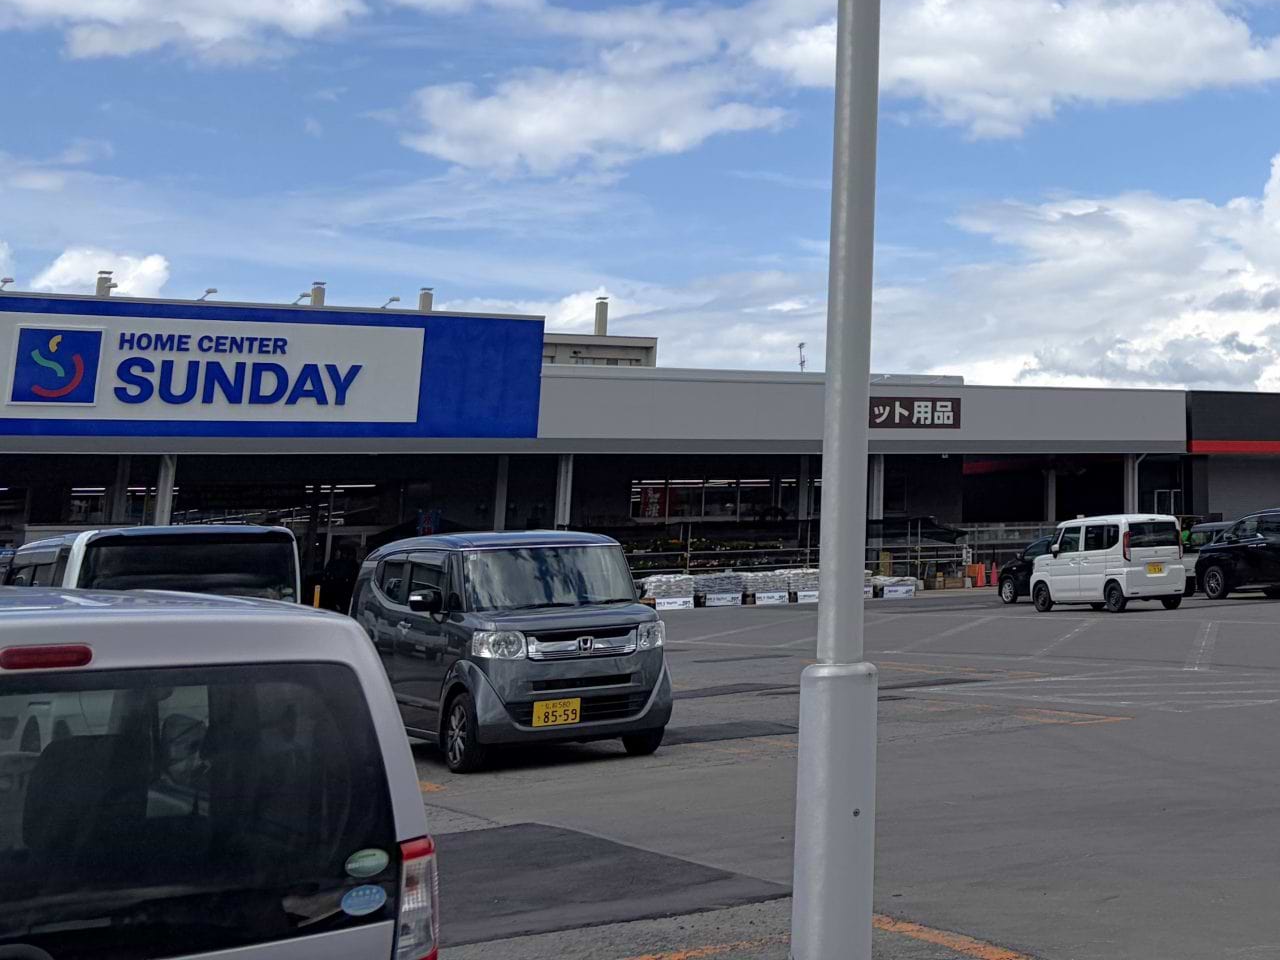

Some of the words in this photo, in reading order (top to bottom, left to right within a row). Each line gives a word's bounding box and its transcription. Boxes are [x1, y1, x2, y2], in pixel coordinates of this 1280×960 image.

[118, 332, 191, 352] HOME
[197, 335, 288, 355] CENTER
[113, 356, 363, 406] SUNDAY
[873, 401, 954, 425] ット用品
[543, 709, 578, 724] 85-59
